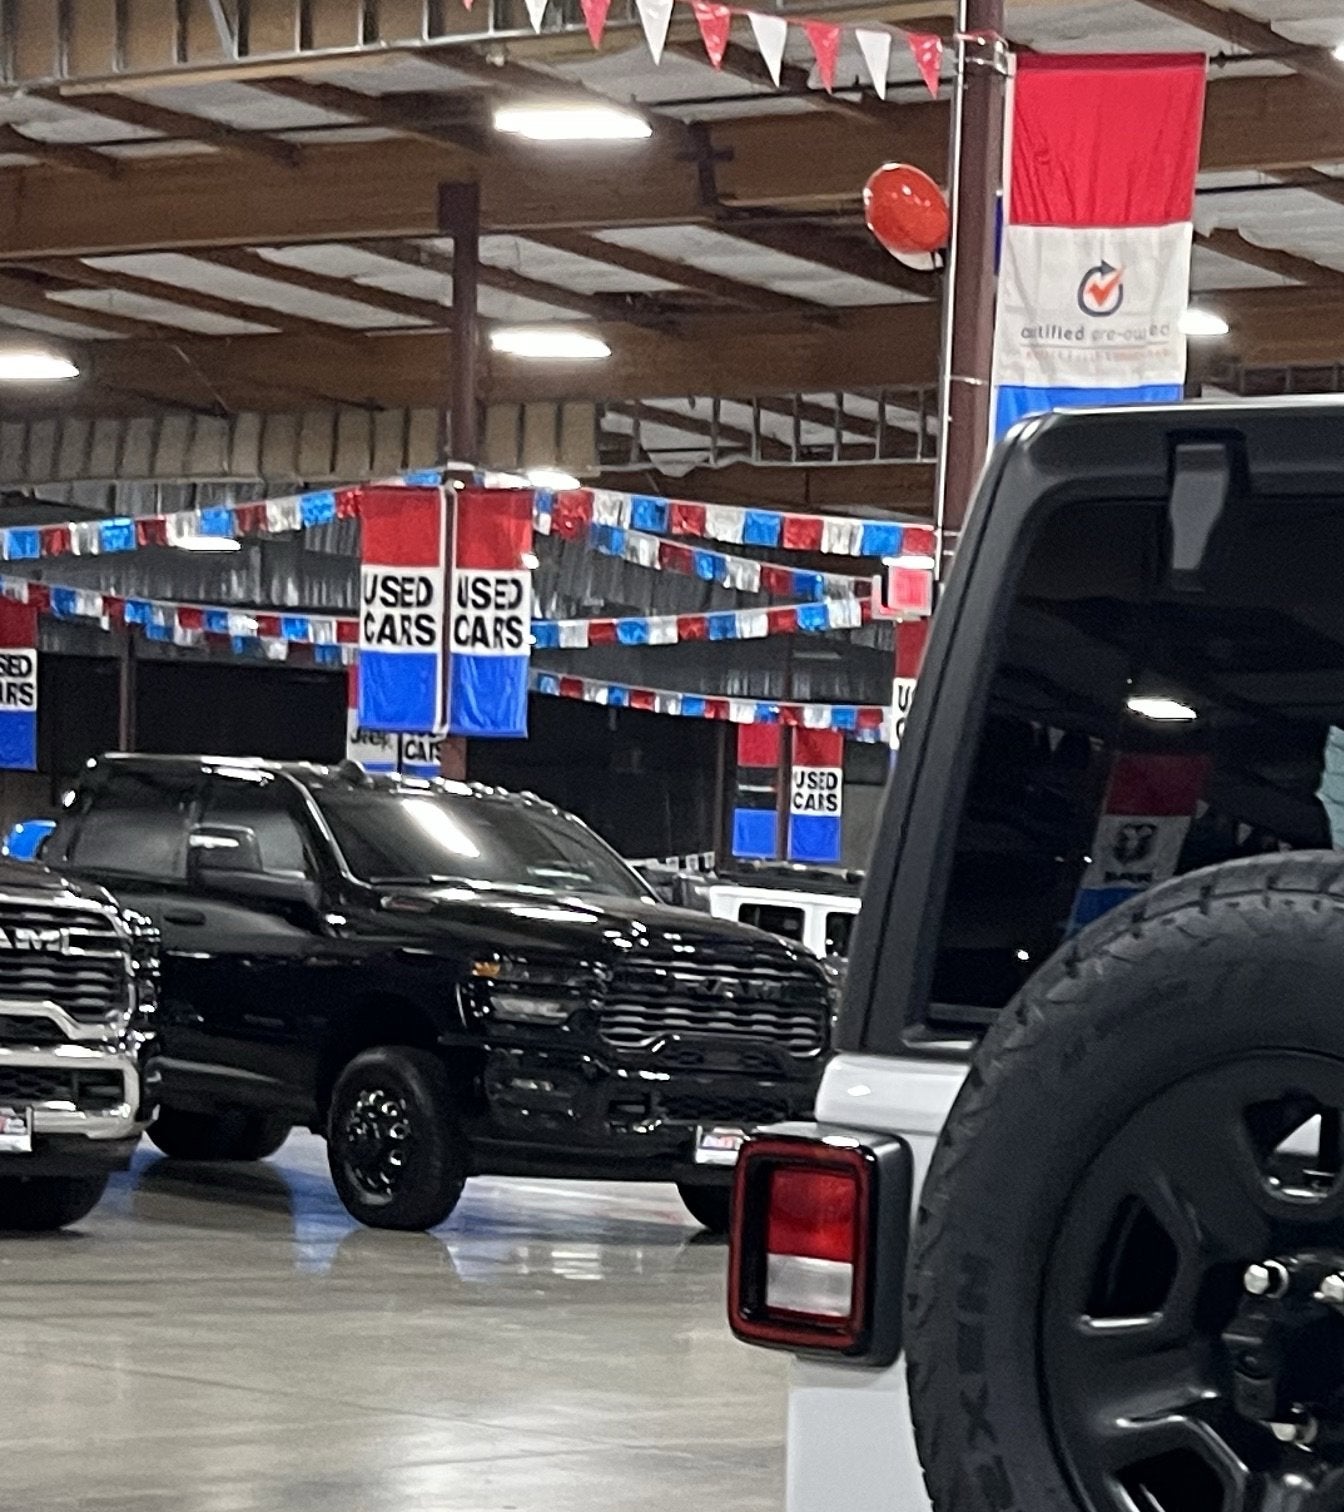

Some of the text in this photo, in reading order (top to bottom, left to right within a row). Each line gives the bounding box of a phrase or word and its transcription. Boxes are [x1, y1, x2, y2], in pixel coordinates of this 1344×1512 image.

[364, 574, 434, 608] USED
[457, 575, 523, 611] USED
[363, 612, 436, 646] CARS
[454, 614, 523, 648] CARS
[794, 771, 839, 790] USED
[793, 792, 838, 812] CARS
